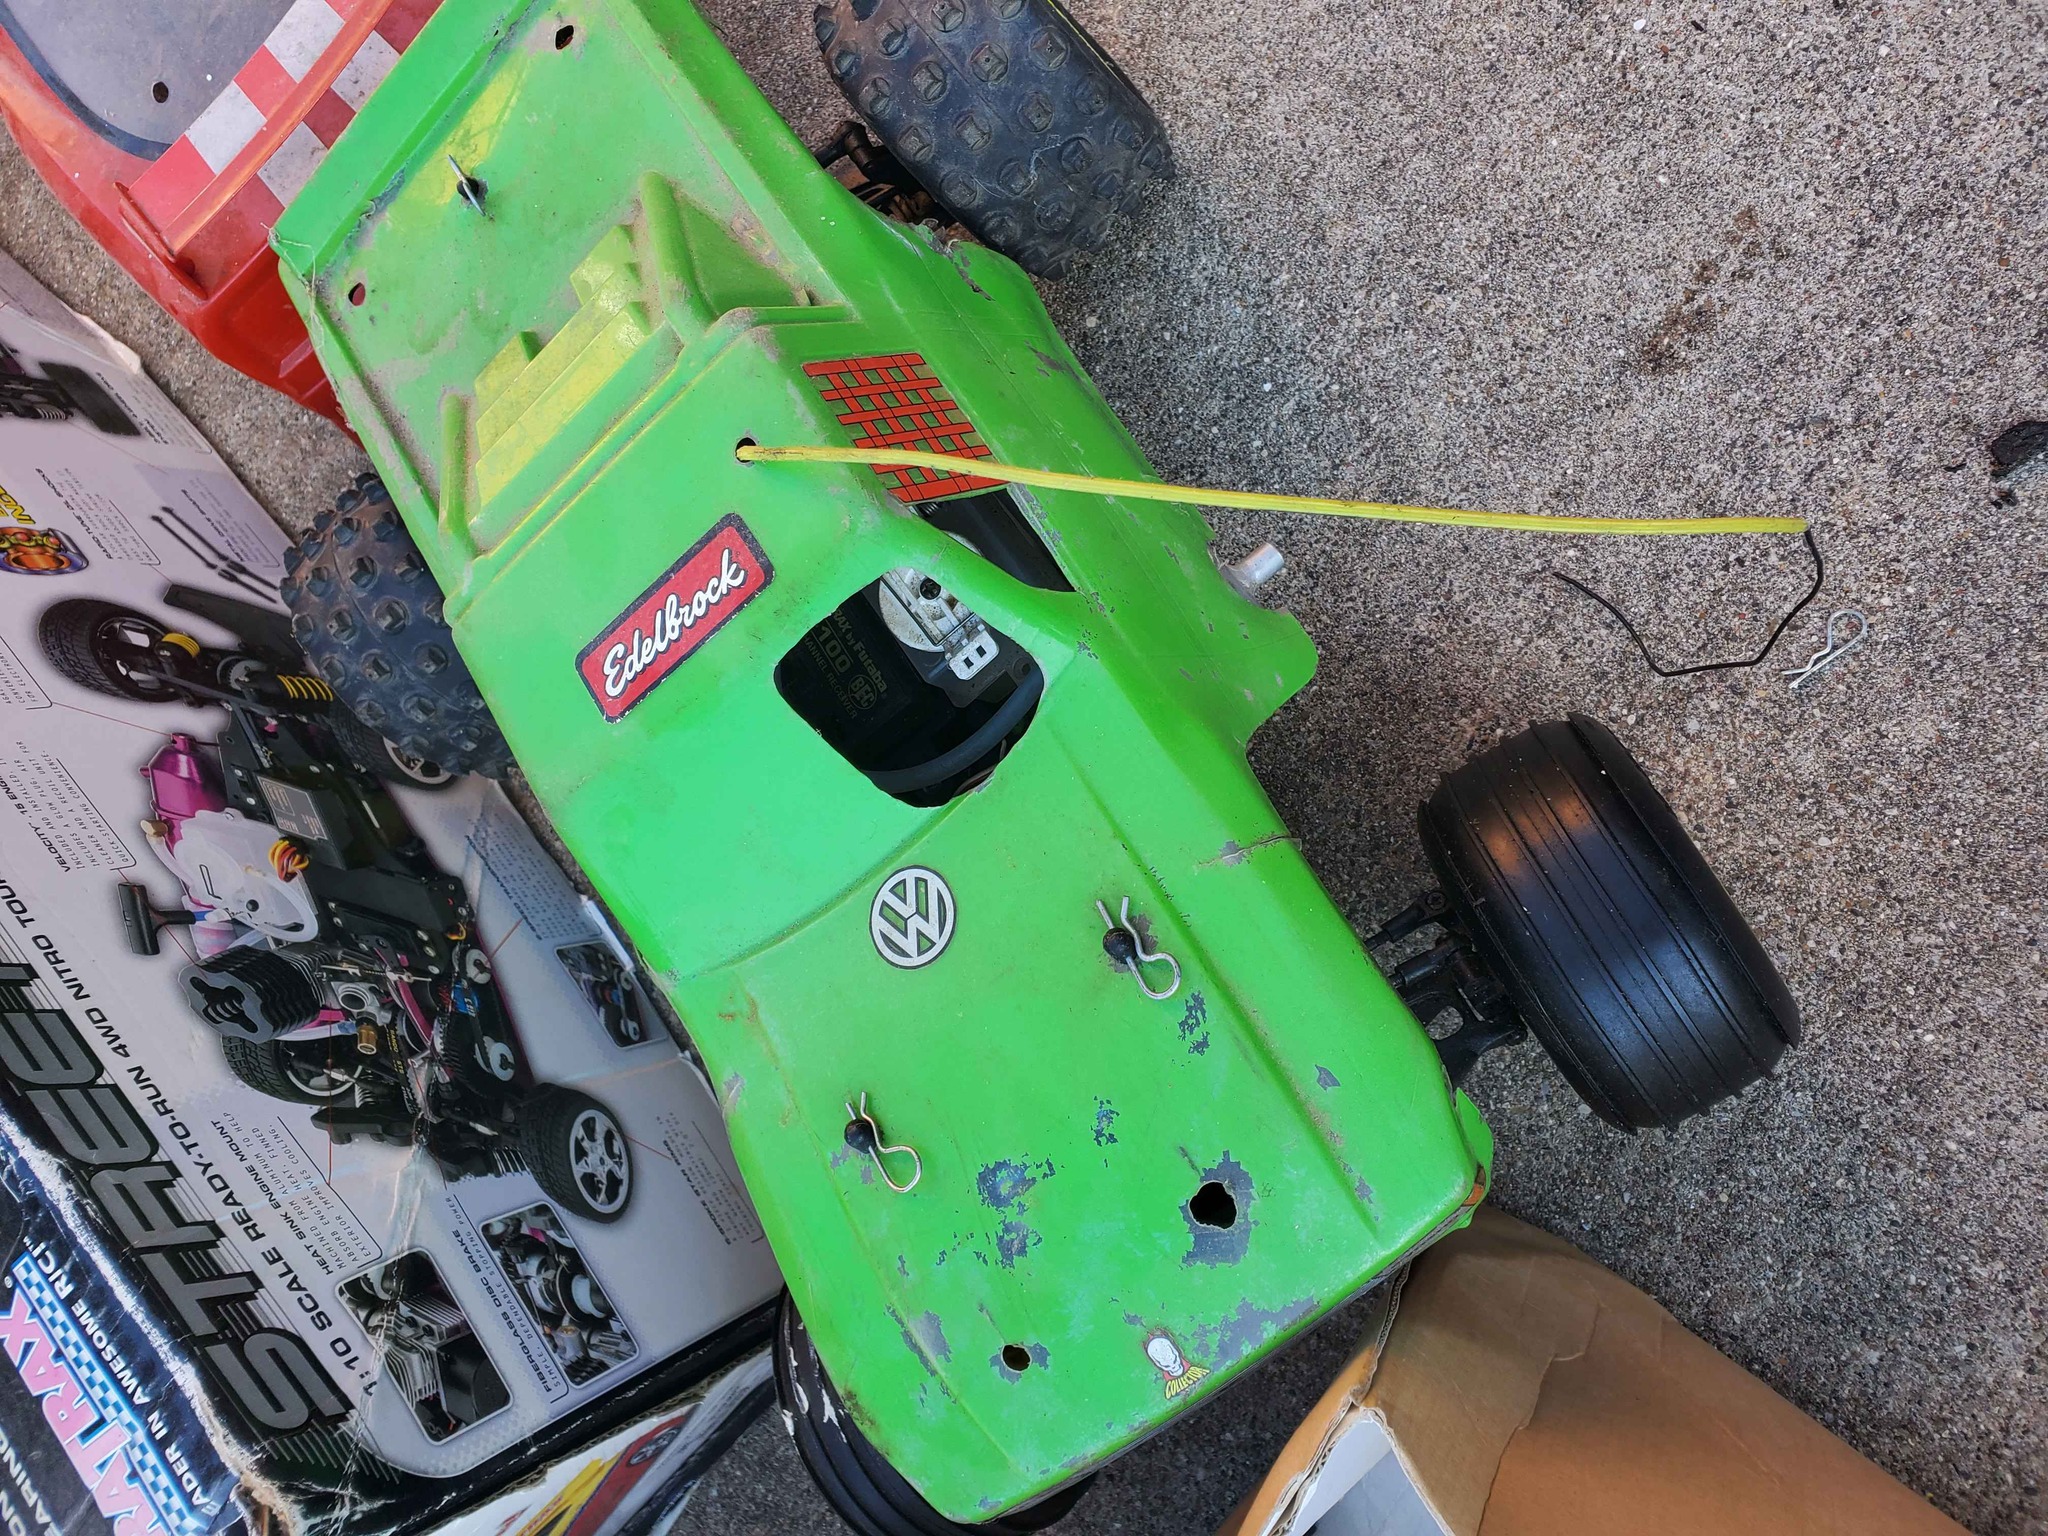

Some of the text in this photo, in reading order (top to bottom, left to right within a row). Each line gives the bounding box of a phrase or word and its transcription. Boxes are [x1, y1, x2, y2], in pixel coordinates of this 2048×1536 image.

[602, 548, 745, 697] Edelbrock
[851, 640, 891, 694] Futaba
[824, 671, 860, 720] RECEIVER
[13, 740, 30, 754] FOR
[11, 758, 29, 773] AIR
[25, 757, 46, 775] UNIT
[42, 779, 69, 804] RECOIL
[39, 816, 57, 830] AND
[71, 816, 89, 830] AND
[77, 802, 130, 862] QUICK-STARTING
[53, 833, 86, 869] INCLUDED
[67, 832, 101, 867] INCLUDES
[85, 833, 116, 865] CLEANER
[0, 880, 382, 1393] 1:10 SCALE READY-TO-RUN 4WD NITRO TOU
[248, 1127, 279, 1159] FINNED
[208, 1118, 335, 1275] HEAT SINK ENGINE MOUNT
[220, 1111, 348, 1269] MACHINED FROM ALUMINUM TO HELP
[296, 1169, 335, 1211] IMPROVES
[299, 1195, 331, 1226] ENGINE
[443, 1194, 466, 1226] POWER
[326, 1230, 360, 1263] ABSORB
[330, 1213, 372, 1258] EXTERIOR
[463, 1228, 496, 1277] STOPPING
[450, 1227, 553, 1392] FIBERGLASS DISC BRAKE
[493, 1279, 534, 1341] DEPENDABLE
[68, 1297, 152, 1408] AWESOME
[1165, 1364, 1210, 1400] COLLECTOR
[144, 1410, 170, 1440] IN
